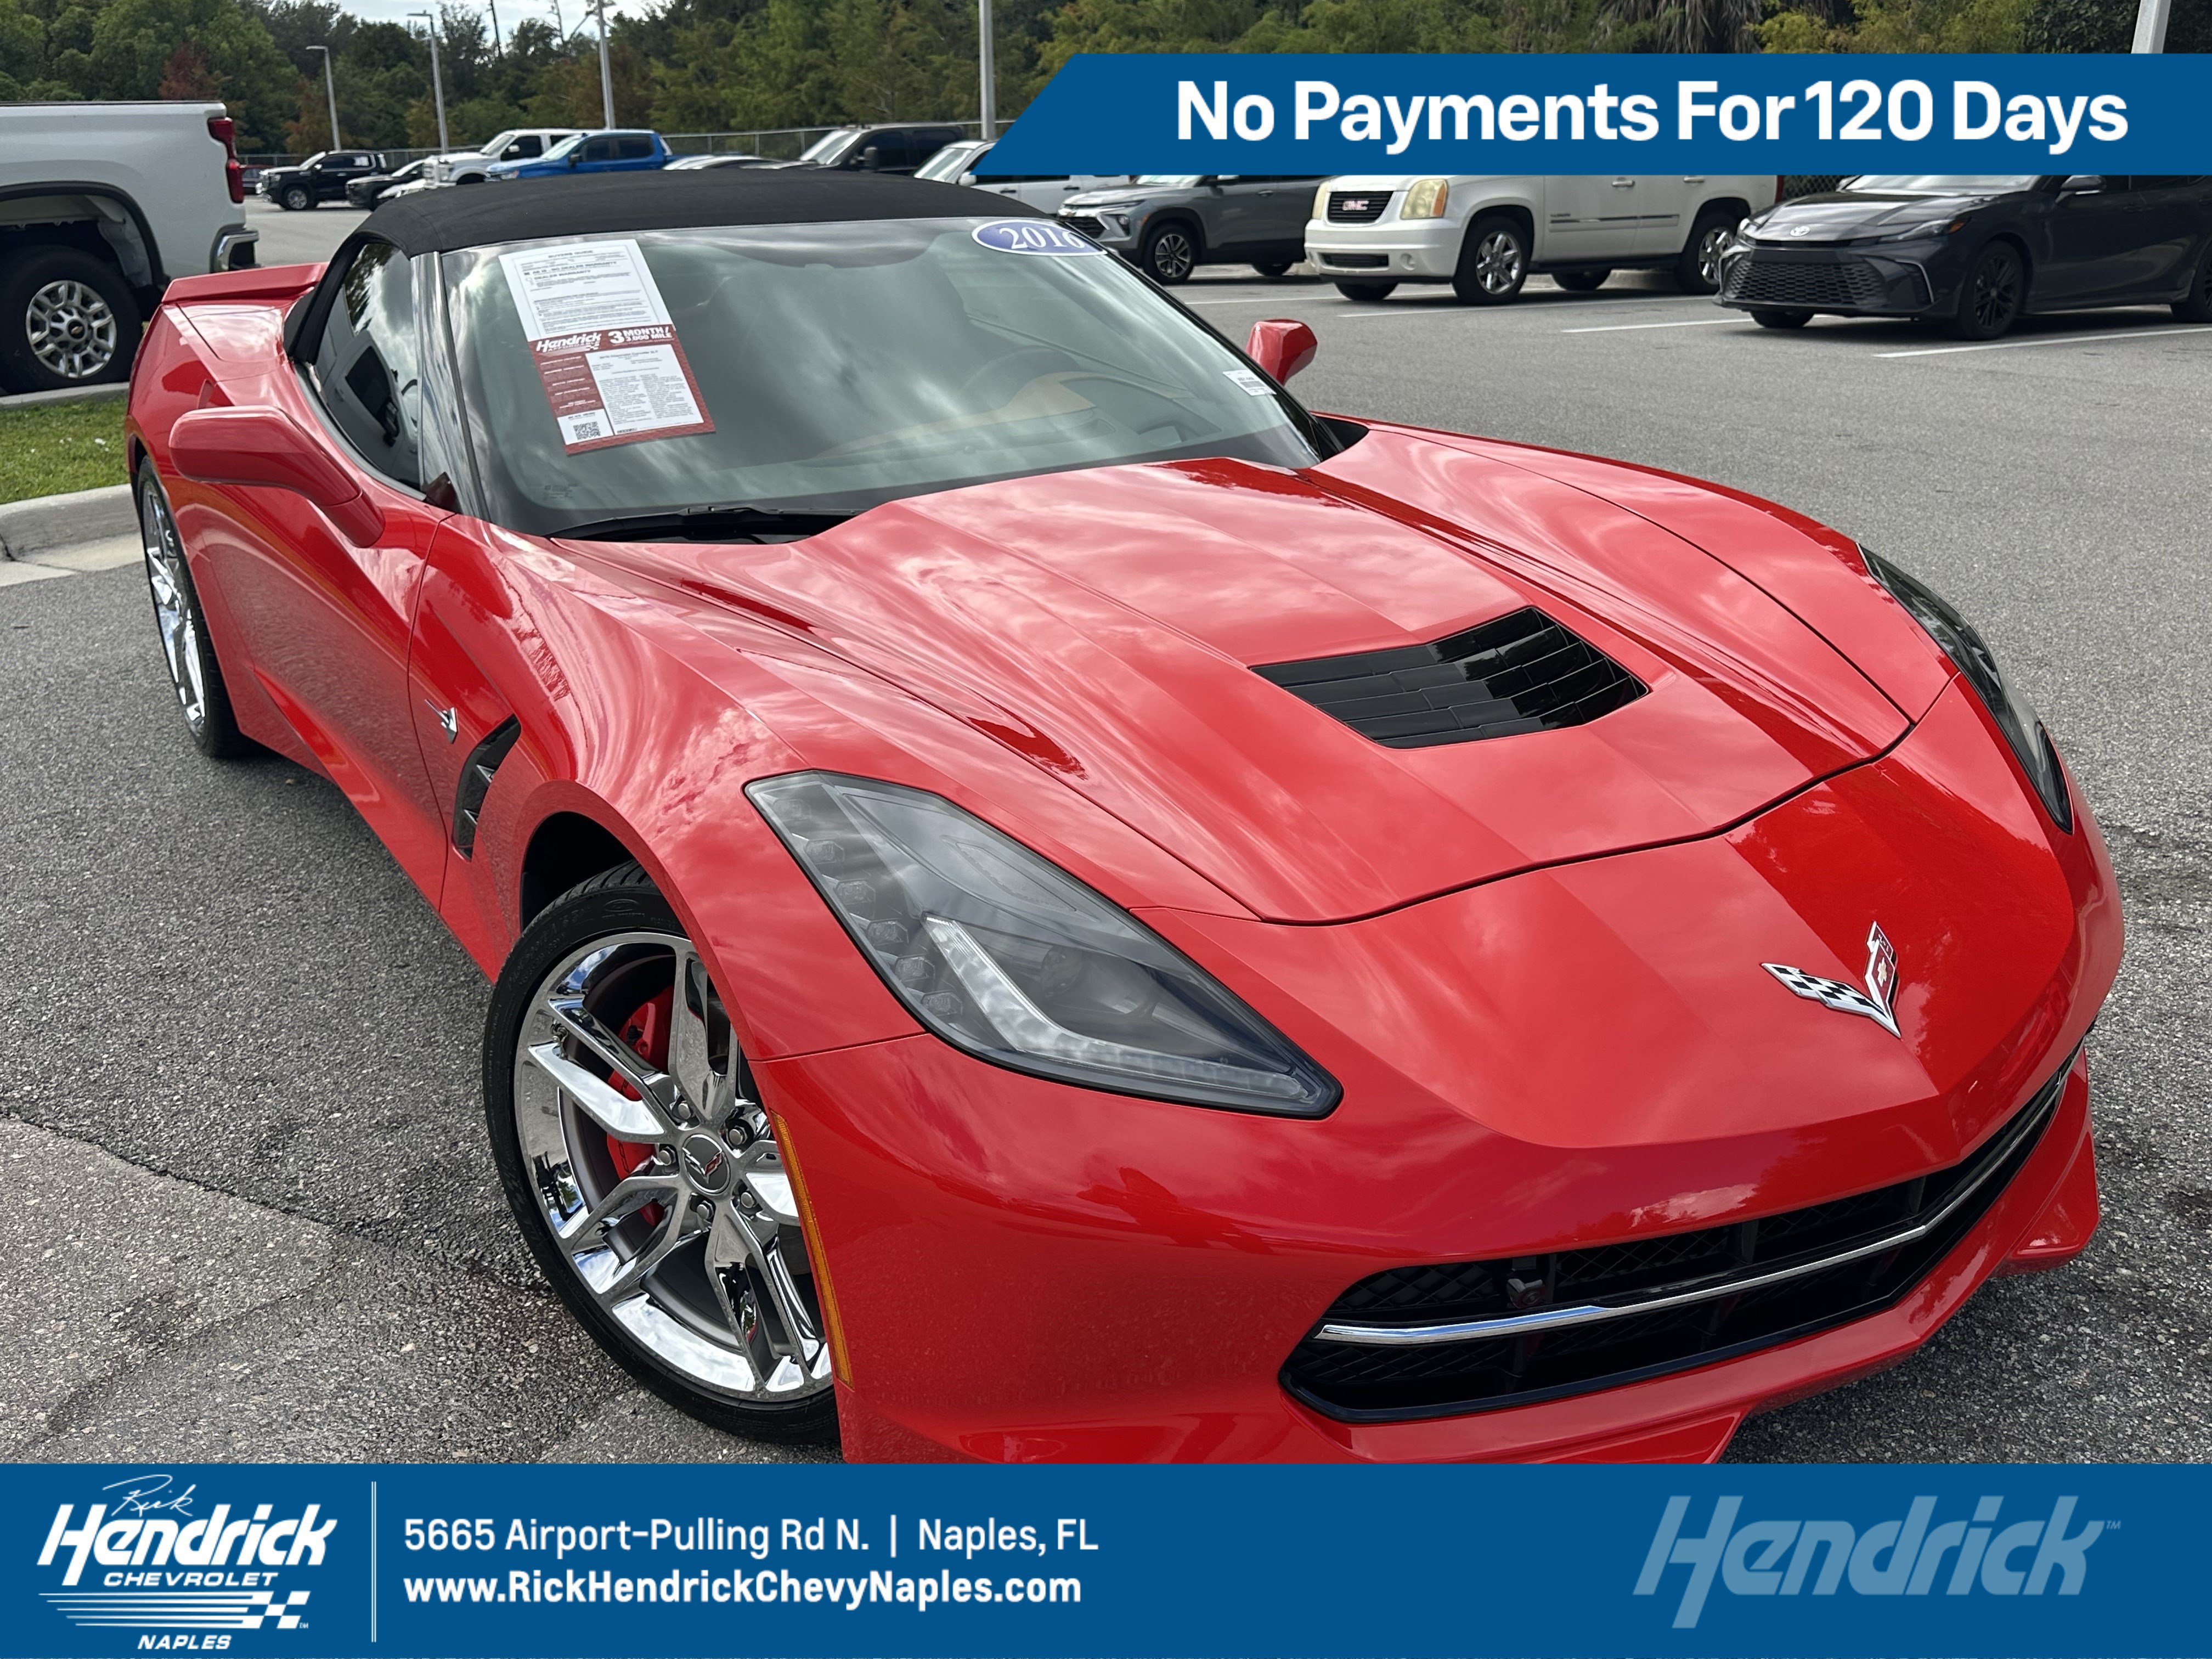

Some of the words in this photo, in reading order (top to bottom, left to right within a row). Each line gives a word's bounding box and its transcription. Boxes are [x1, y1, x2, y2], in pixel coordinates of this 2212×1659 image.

[998, 227, 1085, 249] 2016
[536, 332, 602, 352] Hendrick
[608, 330, 625, 343] 3
